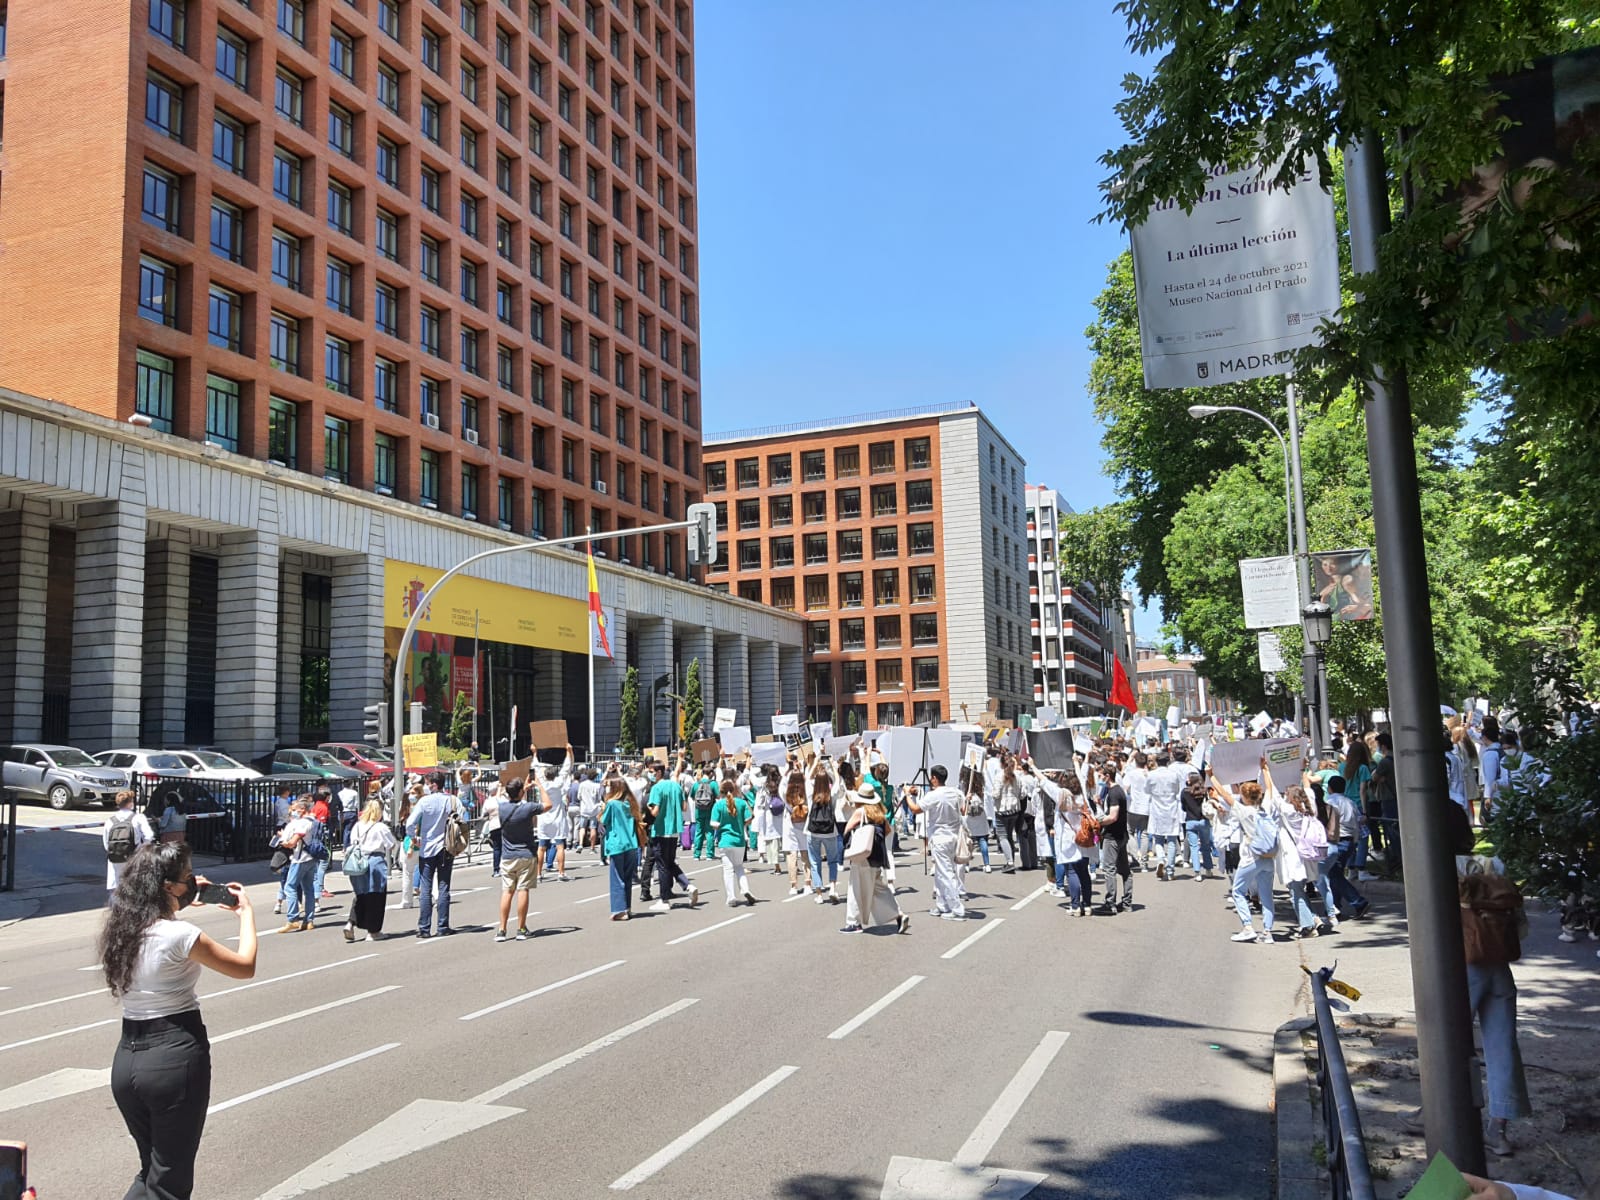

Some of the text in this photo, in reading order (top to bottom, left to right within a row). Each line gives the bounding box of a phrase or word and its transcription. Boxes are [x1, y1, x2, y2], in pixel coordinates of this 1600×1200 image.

[1227, 169, 1313, 199] Sánz
[1167, 228, 1298, 262] La última lección
[1163, 260, 1309, 294] Hasta el 24 de octubre 2021
[1168, 275, 1308, 308] Museo Nacional del Prado
